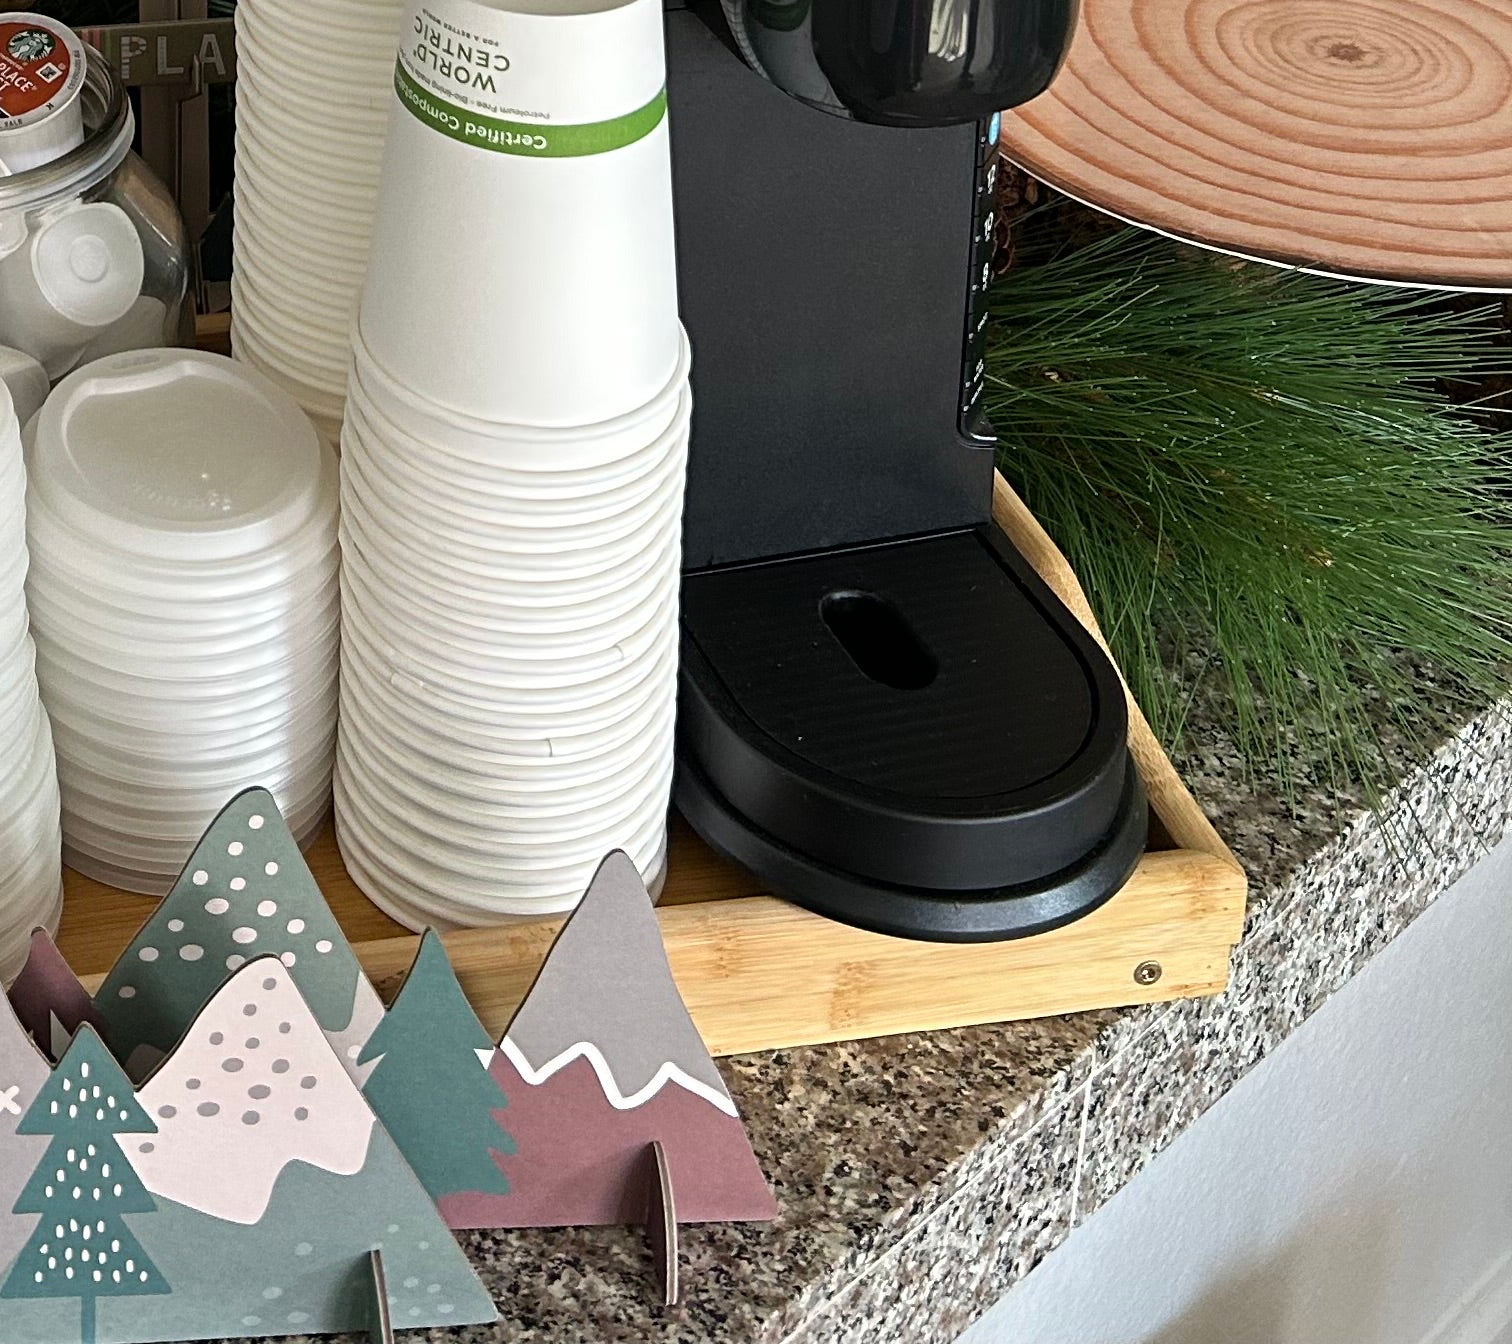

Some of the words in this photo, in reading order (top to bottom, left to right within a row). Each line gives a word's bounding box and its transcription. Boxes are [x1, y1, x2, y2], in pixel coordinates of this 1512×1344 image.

[414, 15, 510, 72] CENTRIC
[416, 43, 497, 94] WORLD
[464, 121, 548, 150] Certified
